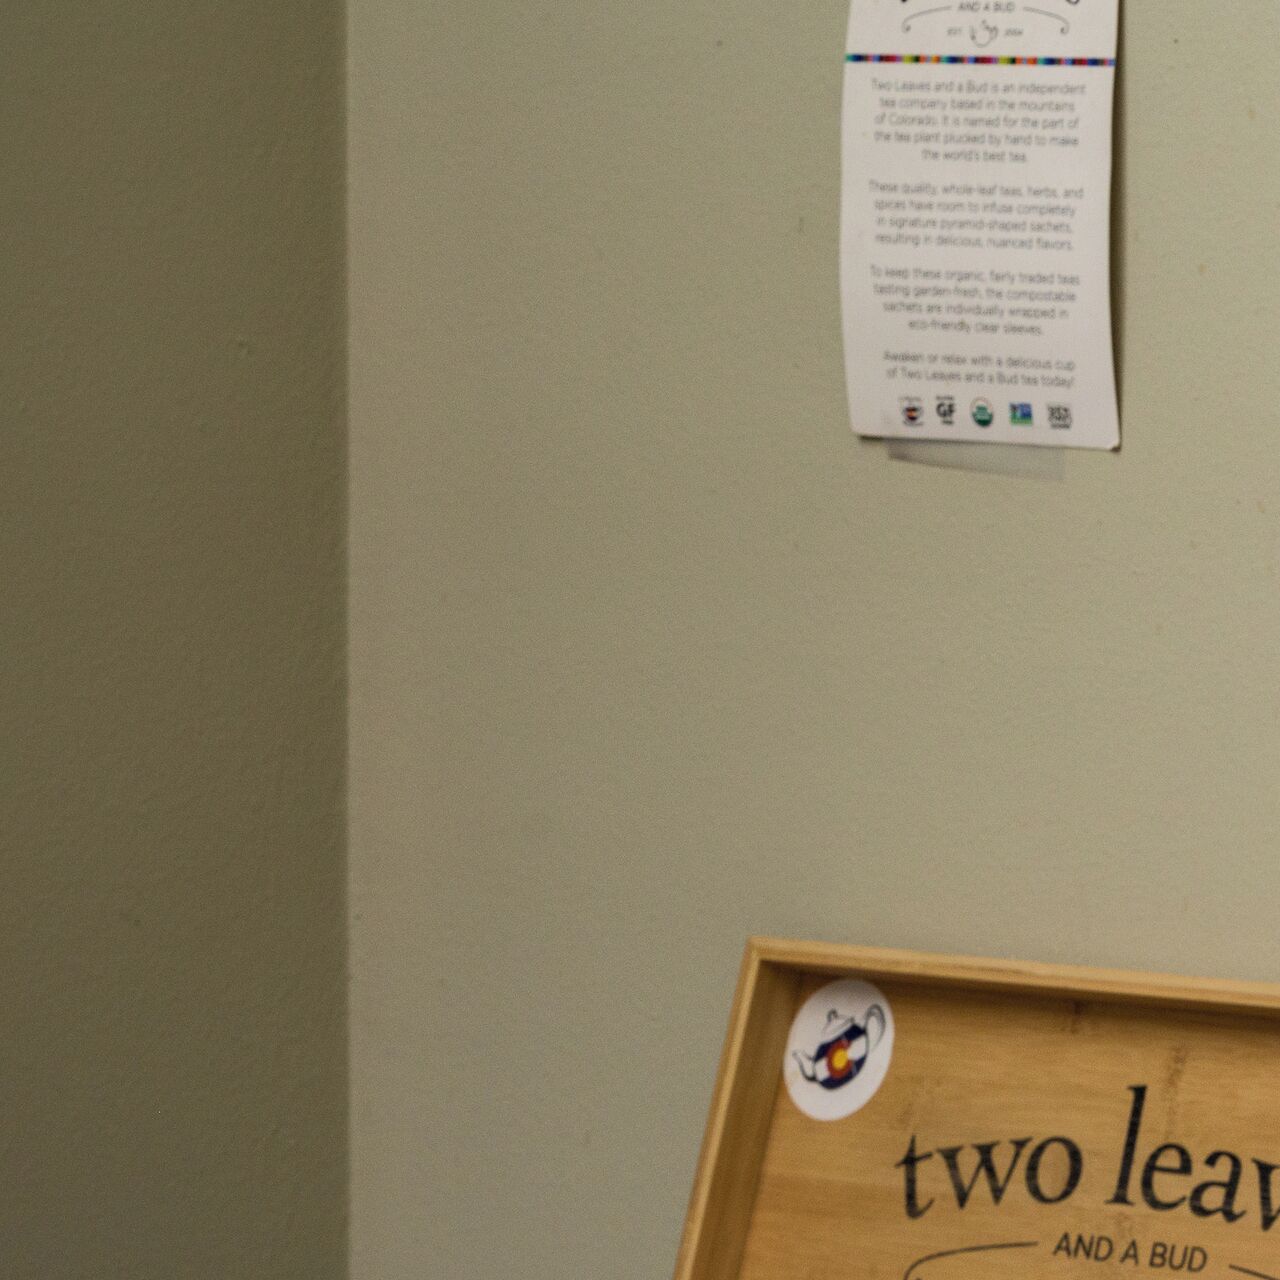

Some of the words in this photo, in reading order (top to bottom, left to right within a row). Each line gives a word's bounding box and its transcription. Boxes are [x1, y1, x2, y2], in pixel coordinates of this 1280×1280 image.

[895, 1134, 1083, 1219] two
[1053, 1232, 1113, 1262] AND
[1120, 1239, 1139, 1265] A
[1149, 1241, 1208, 1273] BUD
